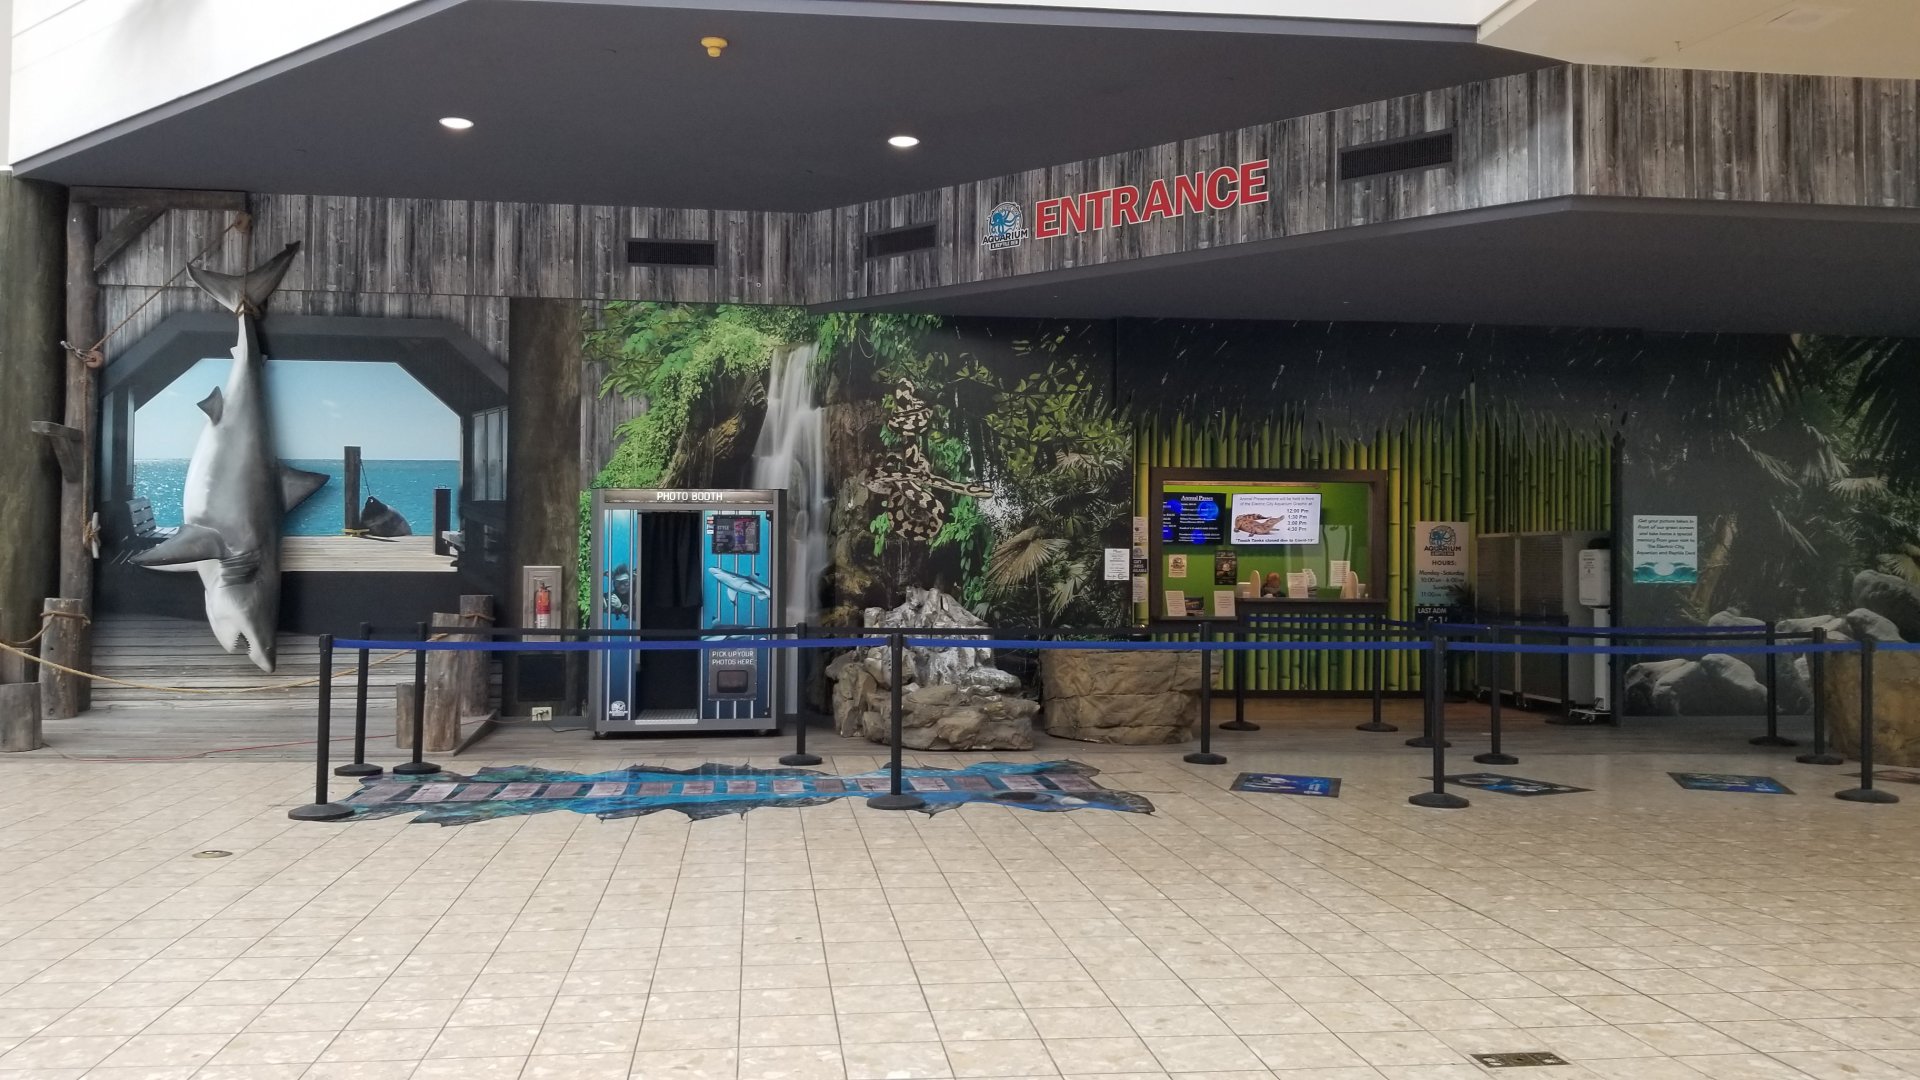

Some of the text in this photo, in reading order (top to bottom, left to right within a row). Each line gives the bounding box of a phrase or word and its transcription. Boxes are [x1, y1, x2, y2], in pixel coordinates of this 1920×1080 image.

[1035, 159, 1269, 240] ENTRANCE
[982, 229, 1029, 245] AQUARIUM
[656, 491, 723, 501] PHOTO BOOTH
